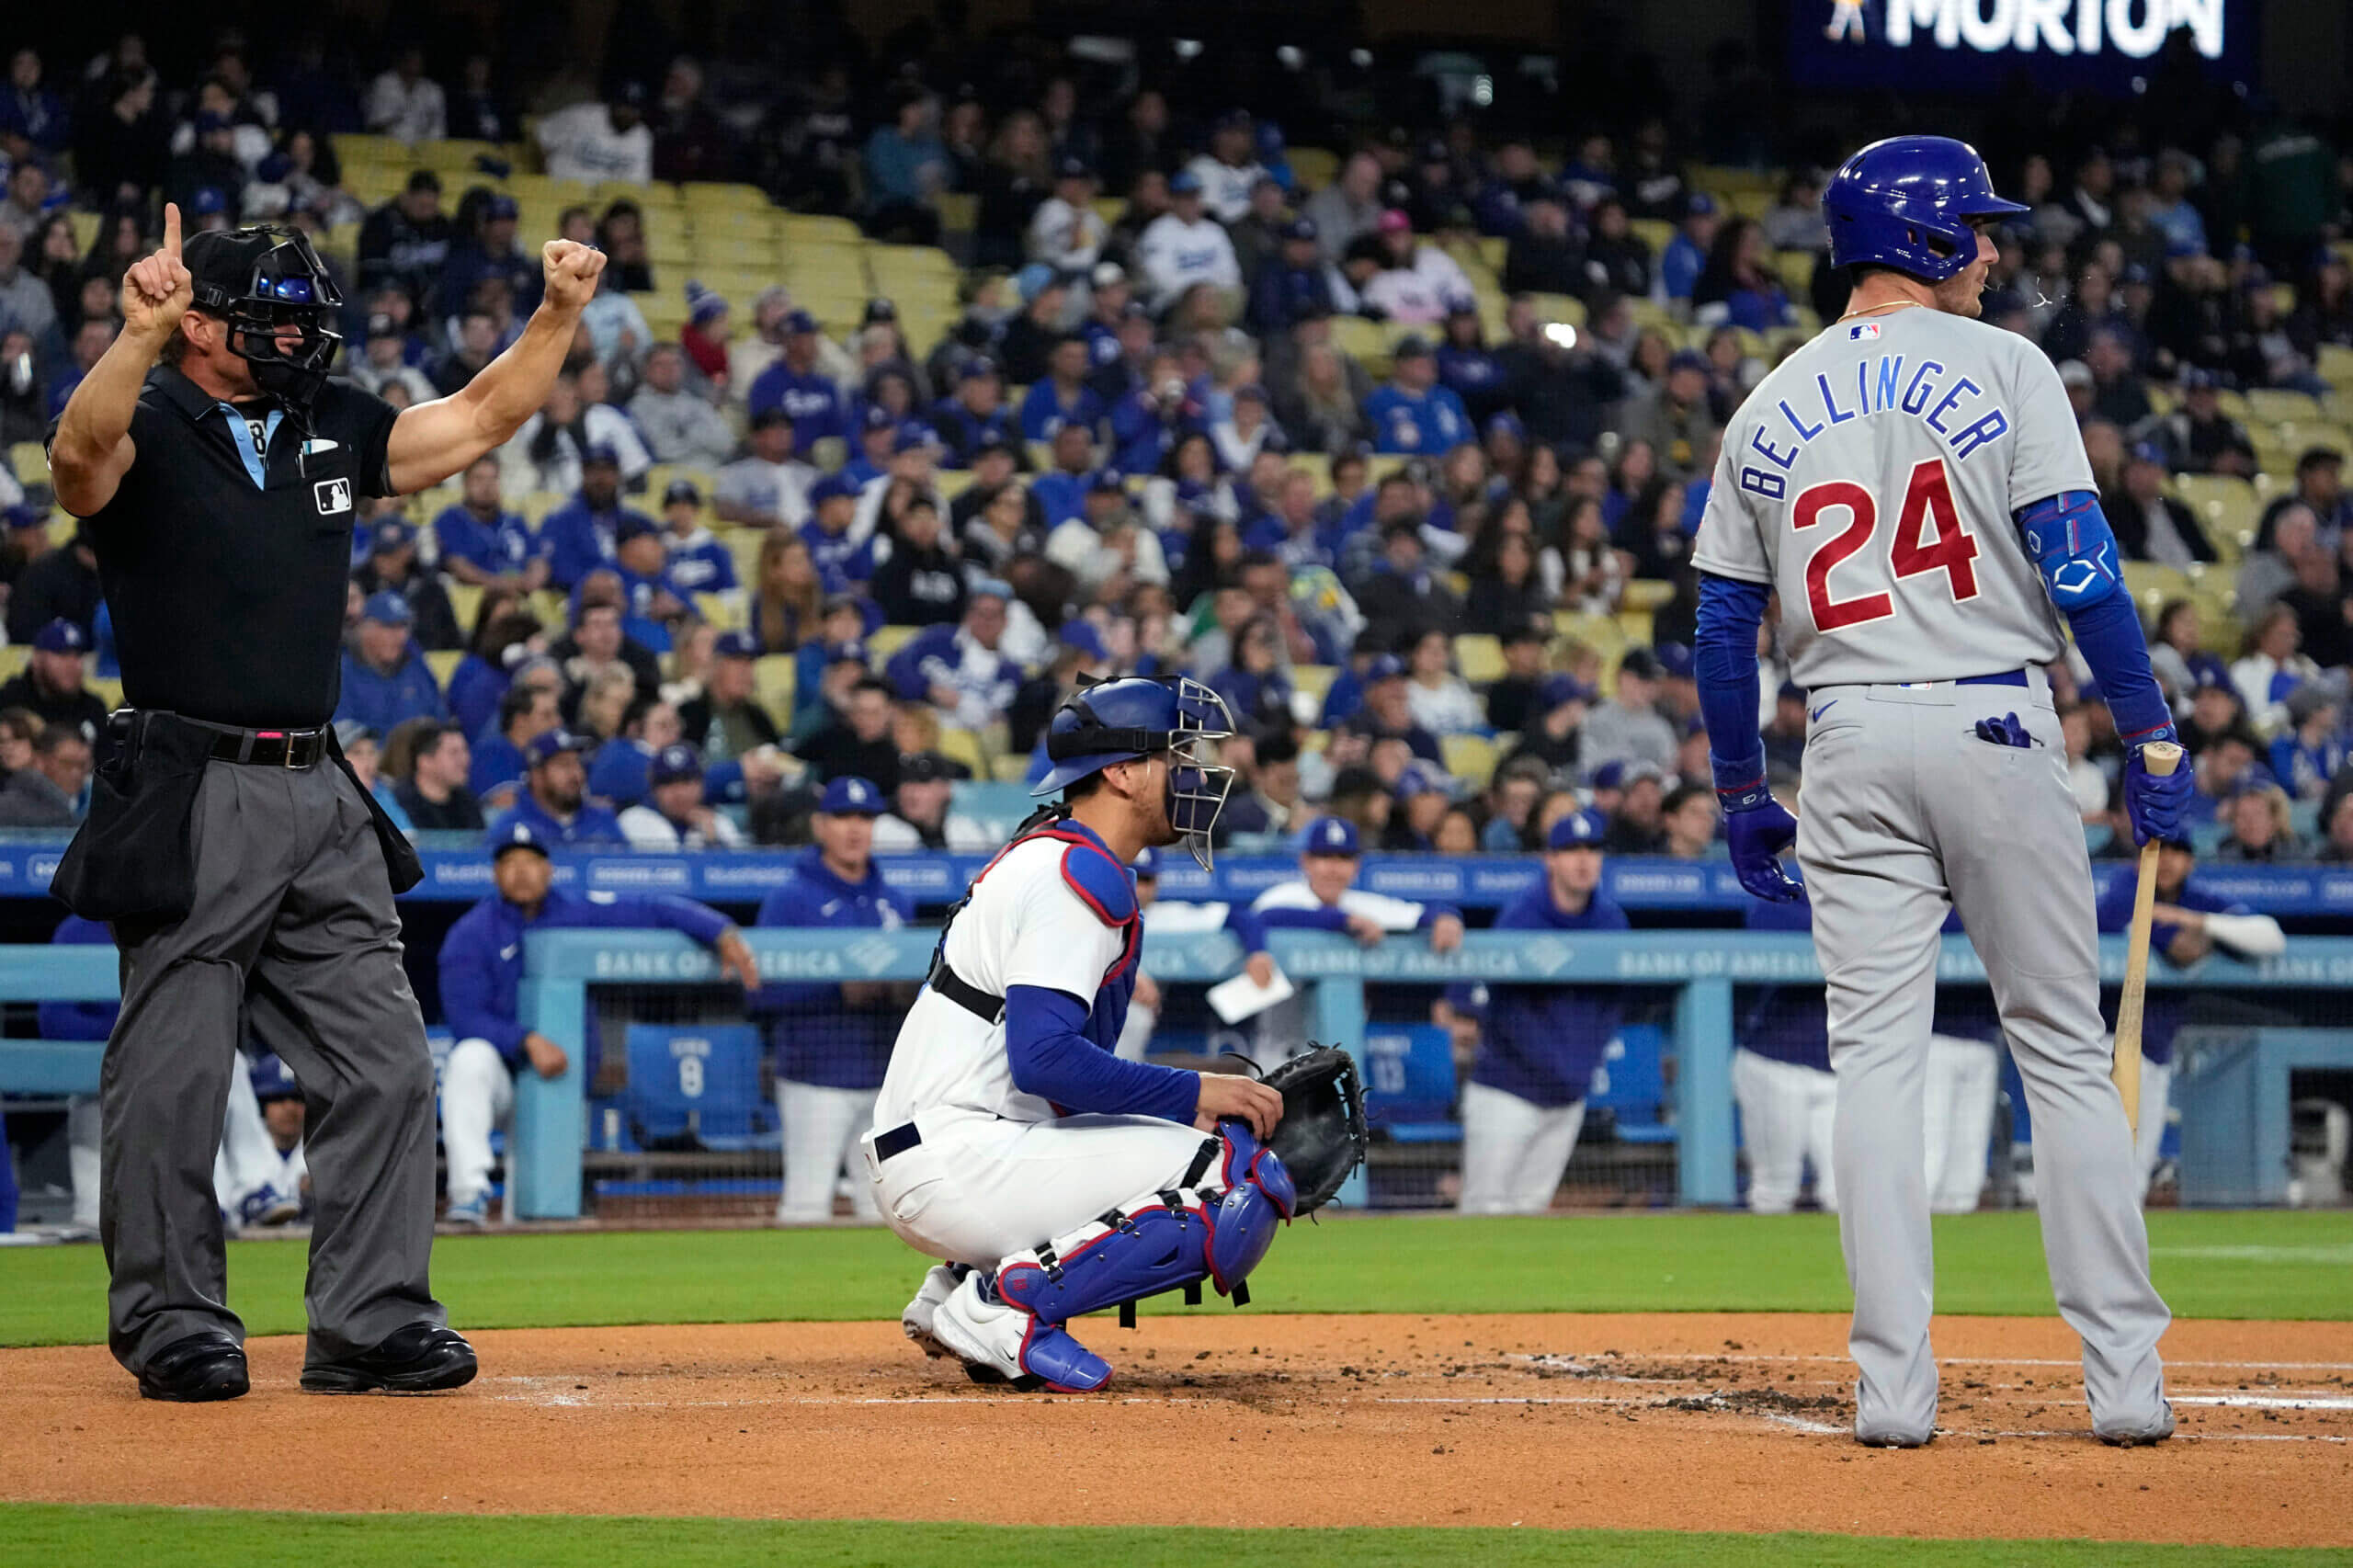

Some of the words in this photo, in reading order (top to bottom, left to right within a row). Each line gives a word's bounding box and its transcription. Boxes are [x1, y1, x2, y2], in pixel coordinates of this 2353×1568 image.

[1740, 354, 2009, 501] BELLINGER
[1790, 455, 1982, 635] 24
[595, 950, 671, 977] BANK
[1290, 950, 1361, 976] BANK
[1402, 950, 1519, 976] AMERICA
[1620, 950, 1688, 976] BANK
[1692, 950, 1726, 976] OF
